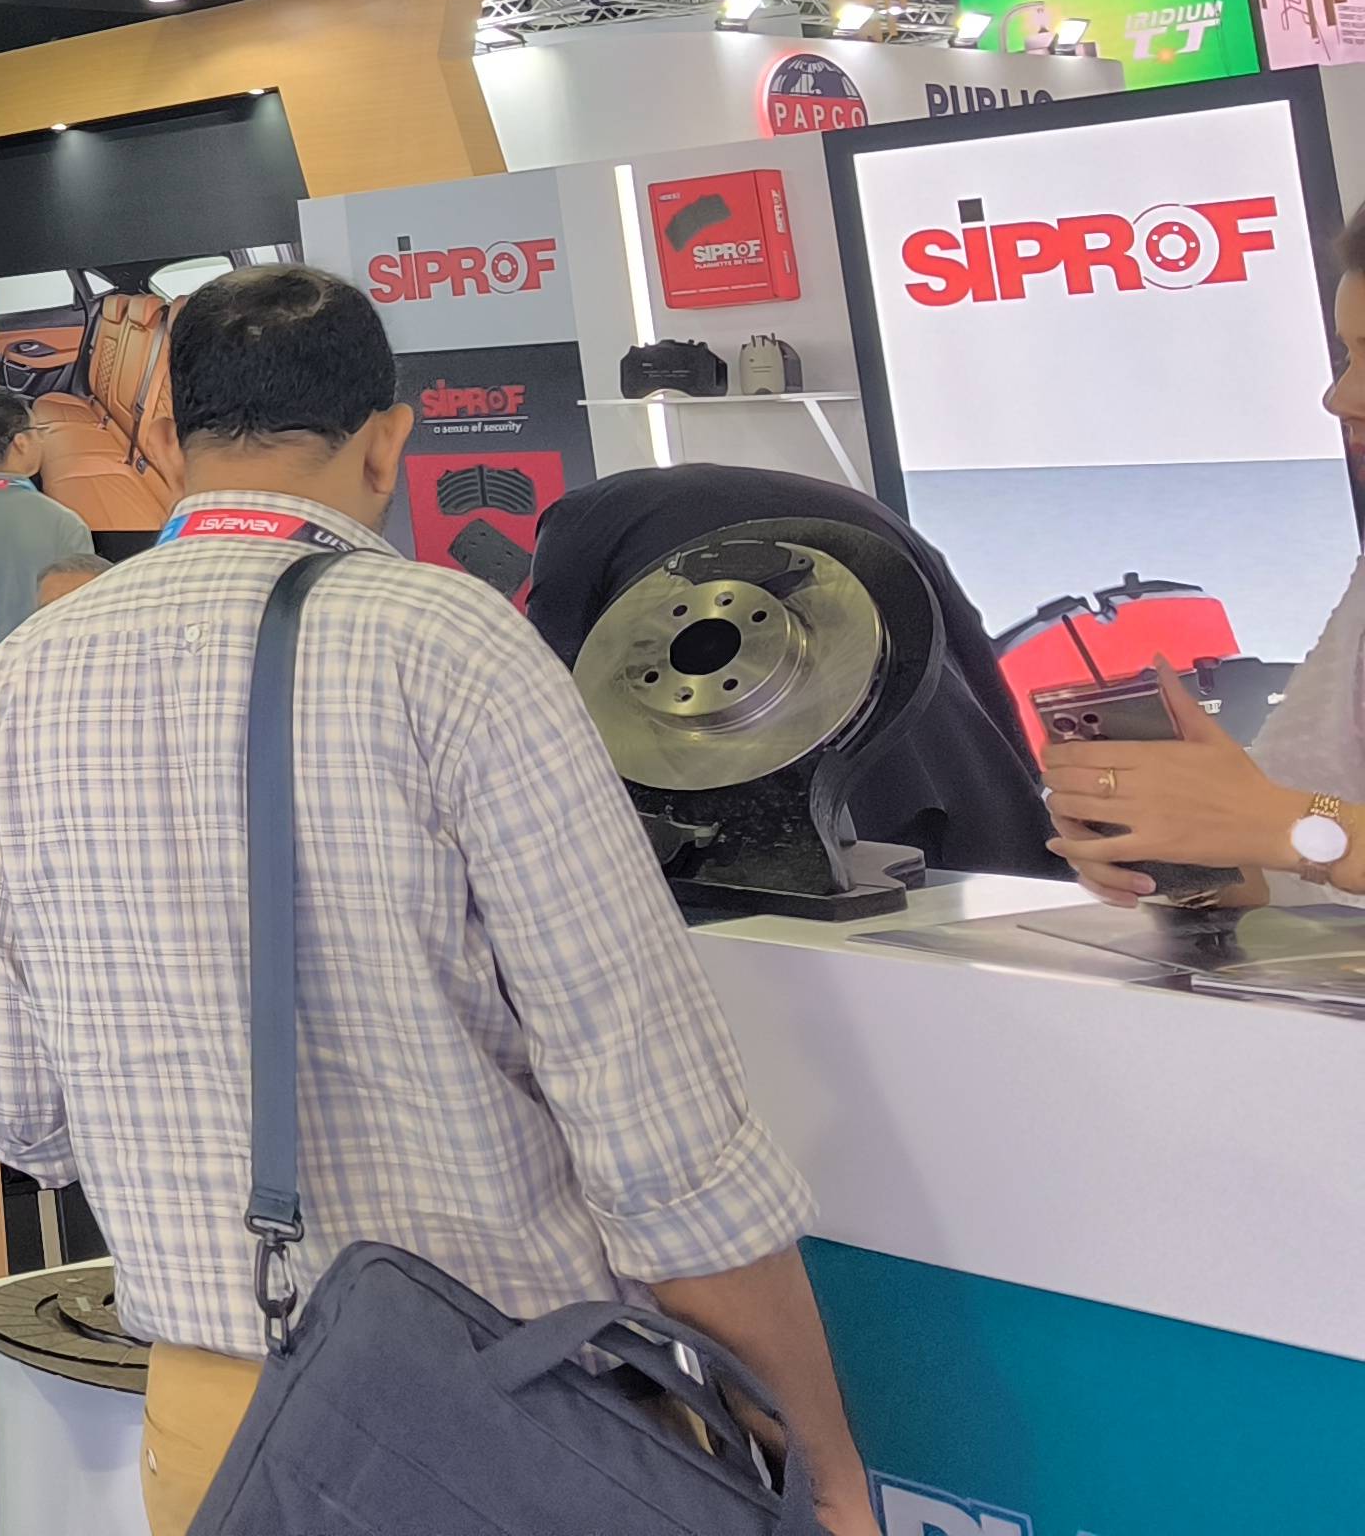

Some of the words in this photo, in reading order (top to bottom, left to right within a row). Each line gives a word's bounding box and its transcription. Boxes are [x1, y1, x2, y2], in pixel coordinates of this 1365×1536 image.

[1126, 0, 1223, 31] IRIDIUM
[775, 101, 866, 129] PAPCO
[925, 83, 1053, 118] PUB
[471, 422, 483, 432] of
[484, 421, 522, 433] security
